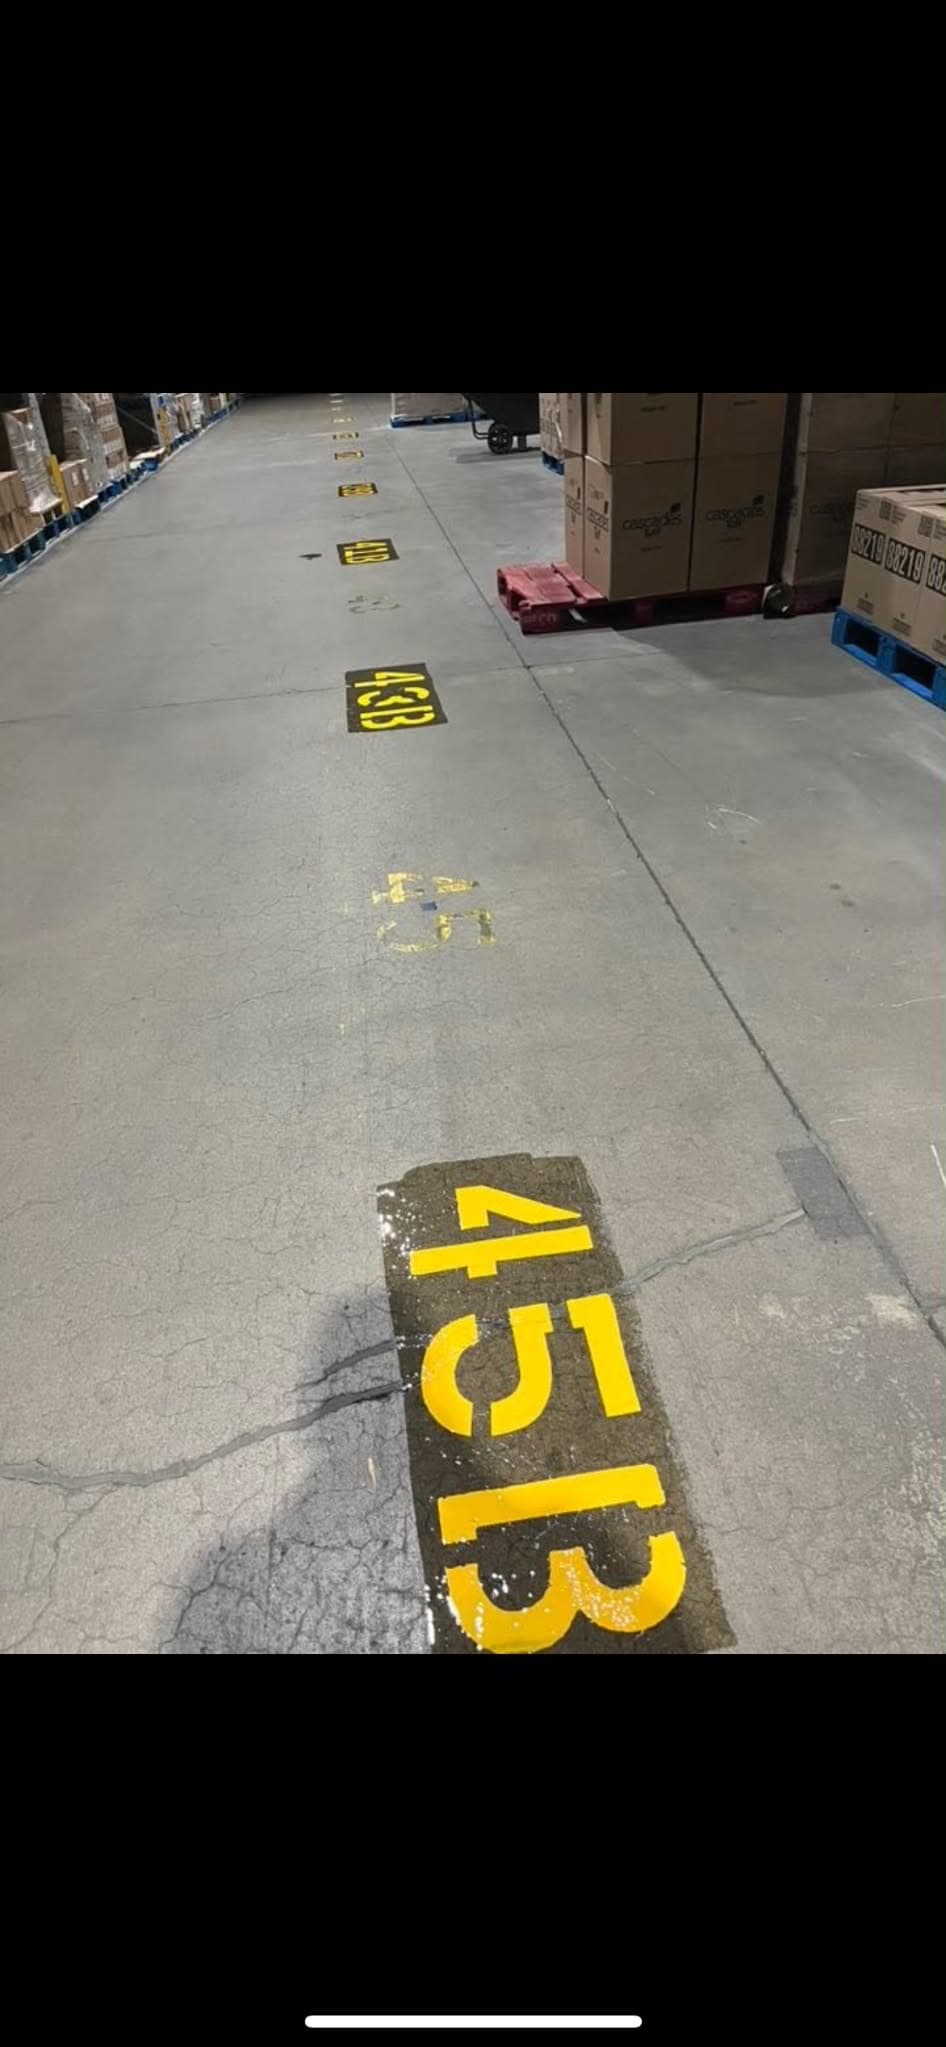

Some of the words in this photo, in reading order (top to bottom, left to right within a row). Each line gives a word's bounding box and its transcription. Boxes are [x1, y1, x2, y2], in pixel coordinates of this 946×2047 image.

[851, 526, 886, 564] 88219
[886, 539, 924, 582] 88219
[354, 671, 436, 731] 43B
[410, 1185, 687, 1654] 45B
